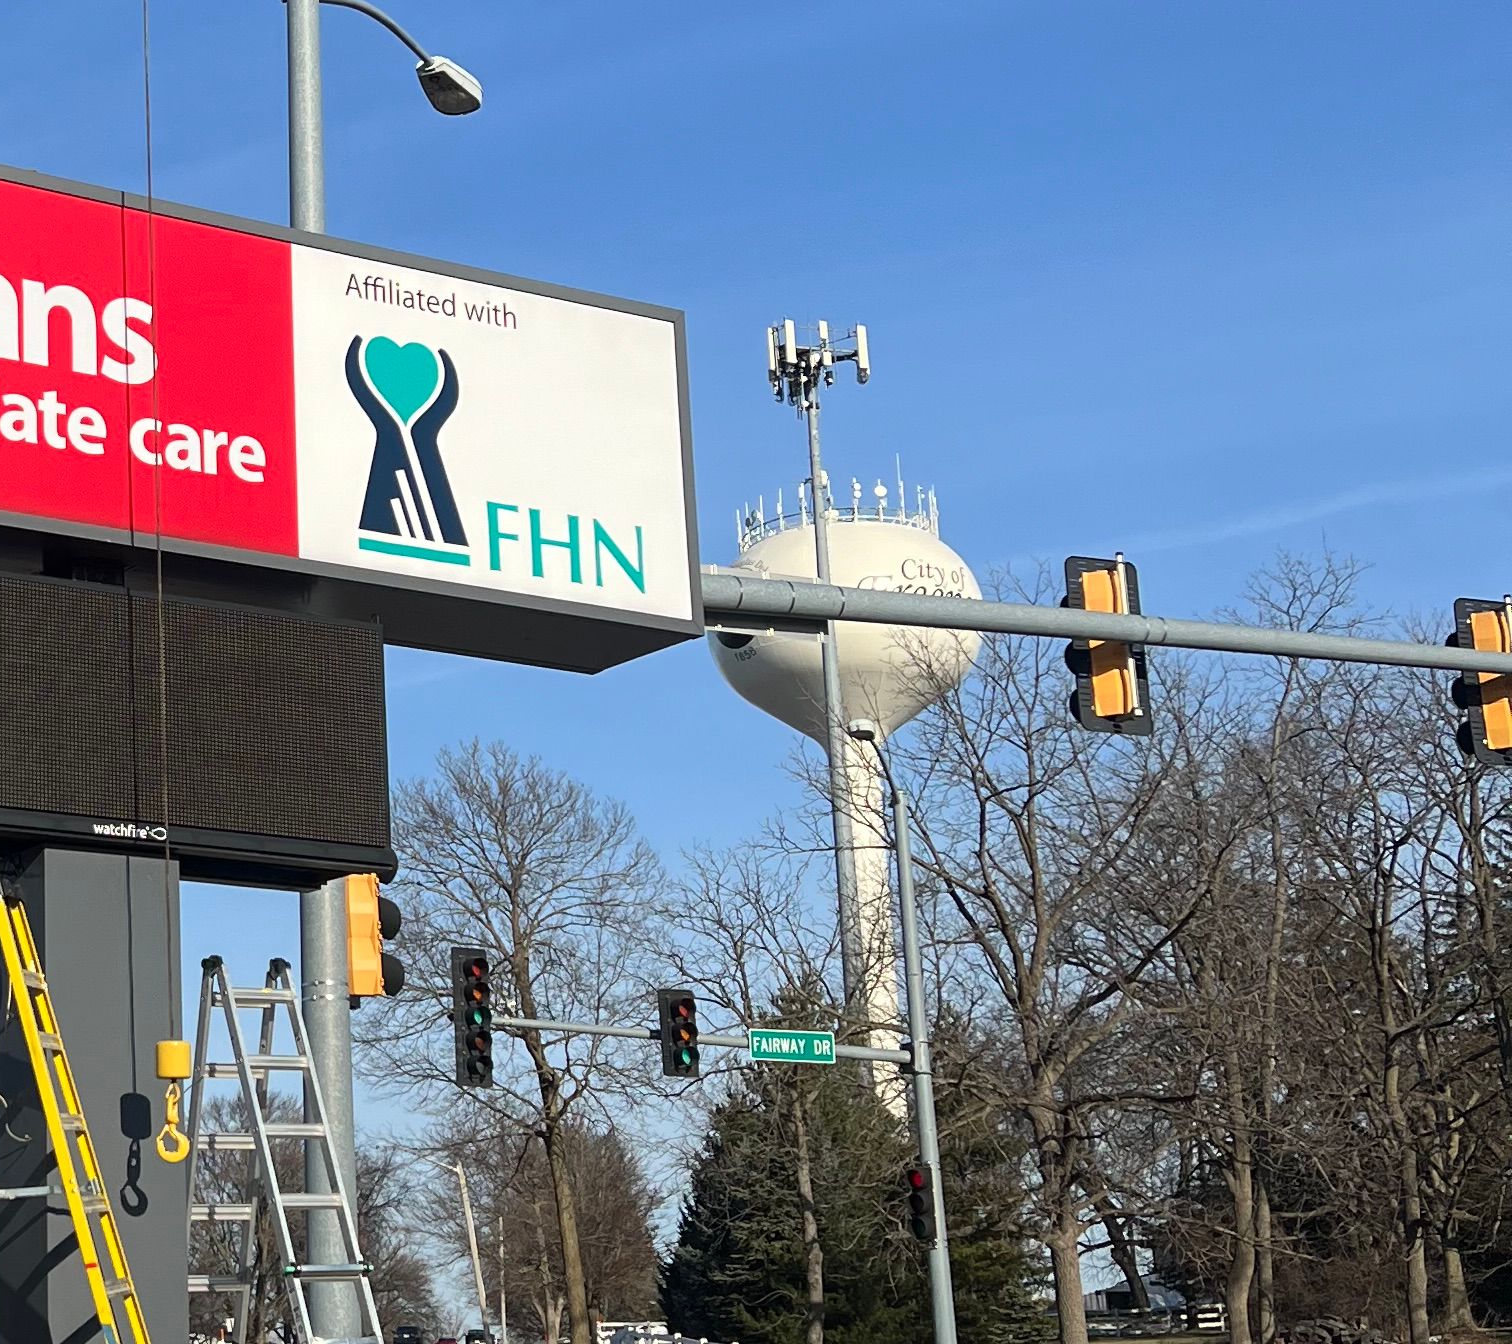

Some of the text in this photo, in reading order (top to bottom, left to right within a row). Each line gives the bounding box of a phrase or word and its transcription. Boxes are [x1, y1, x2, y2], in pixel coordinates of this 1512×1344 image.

[346, 273, 517, 329] Affiliated with
[130, 417, 266, 483] care
[486, 501, 645, 594] FHN
[901, 558, 946, 588] City
[951, 567, 965, 592] of
[93, 822, 149, 839] watchfire
[753, 1037, 831, 1056] FAIRWAY DR
